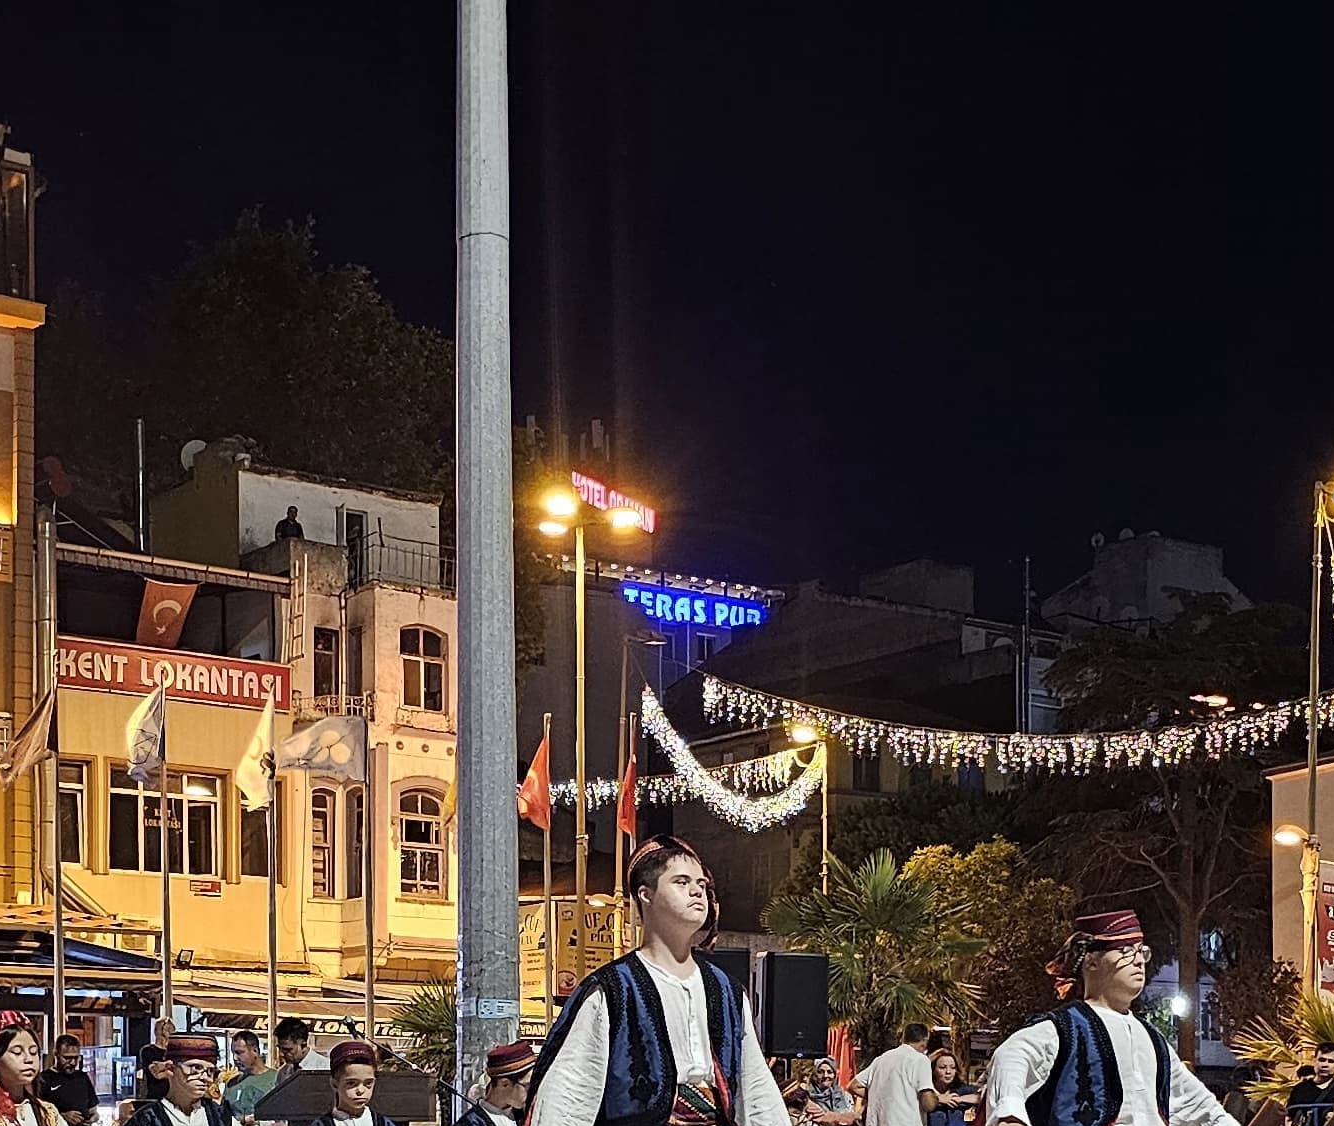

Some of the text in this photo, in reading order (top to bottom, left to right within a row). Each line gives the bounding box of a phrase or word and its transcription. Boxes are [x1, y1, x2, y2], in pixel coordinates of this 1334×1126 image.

[624, 588, 708, 625] TERAS
[59, 649, 282, 702] KENT LOKANTASI
